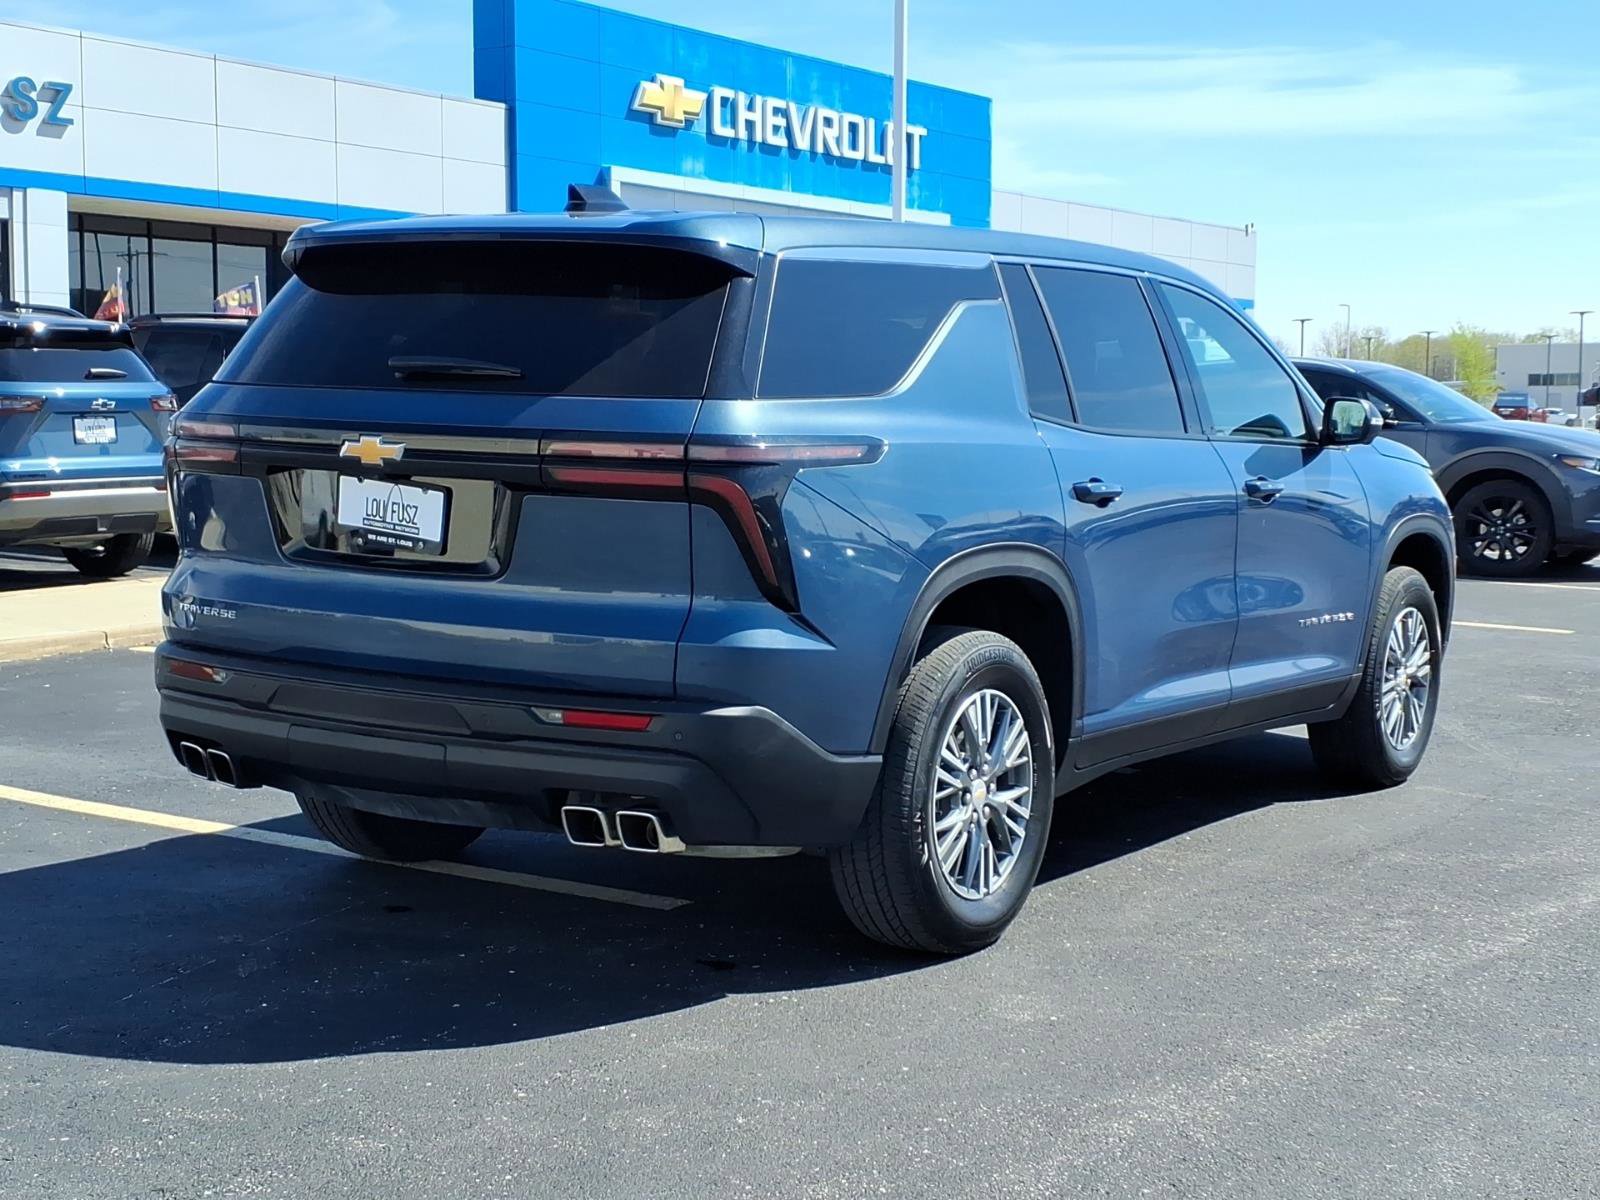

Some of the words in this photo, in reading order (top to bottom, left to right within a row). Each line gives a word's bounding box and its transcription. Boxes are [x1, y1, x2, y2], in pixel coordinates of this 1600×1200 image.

[366, 497, 386, 518] LOU
[391, 501, 418, 525] FUSZ
[180, 602, 237, 619] TRAVERSE
